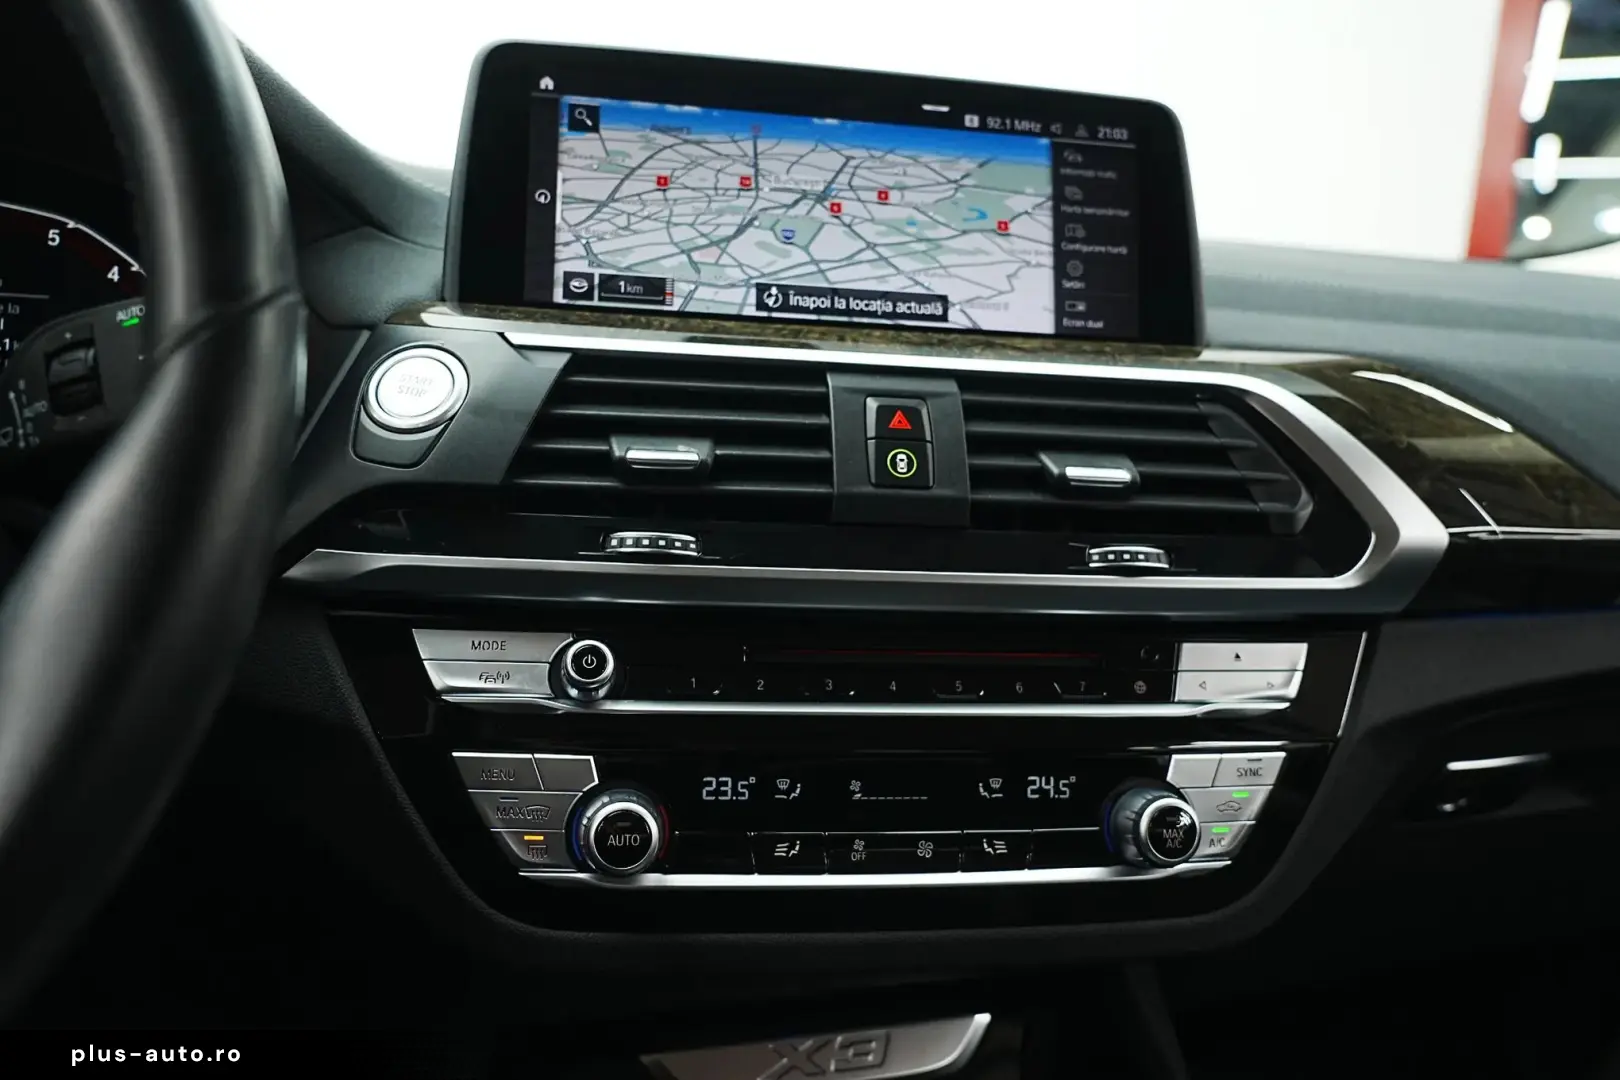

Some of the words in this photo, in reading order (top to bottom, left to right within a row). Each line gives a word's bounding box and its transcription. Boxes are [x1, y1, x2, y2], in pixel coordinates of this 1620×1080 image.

[986, 115, 1011, 130] 92.1
[1013, 119, 1042, 133] MHz
[47, 229, 60, 246] 5
[107, 265, 120, 282] 4
[619, 281, 625, 294] 1
[626, 283, 644, 294] km
[788, 290, 831, 310] Înapoi
[834, 297, 846, 309] la
[116, 304, 146, 322] AUTO
[471, 640, 507, 651] MODE
[756, 679, 765, 691] 2
[824, 679, 833, 691] 3
[889, 680, 897, 692] 4
[954, 680, 963, 692] 5
[1014, 682, 1024, 694] 6
[1079, 681, 1087, 692] 7
[480, 768, 516, 781] MENU
[1236, 766, 1263, 778] SYNC
[495, 805, 525, 819] MAX
[607, 833, 640, 847] AUTO
[1163, 828, 1185, 840] MAX
[1166, 838, 1183, 849] A/C
[1208, 837, 1226, 849] A/C
[851, 851, 866, 861] OFF
[756, 1029, 892, 1080] X3
